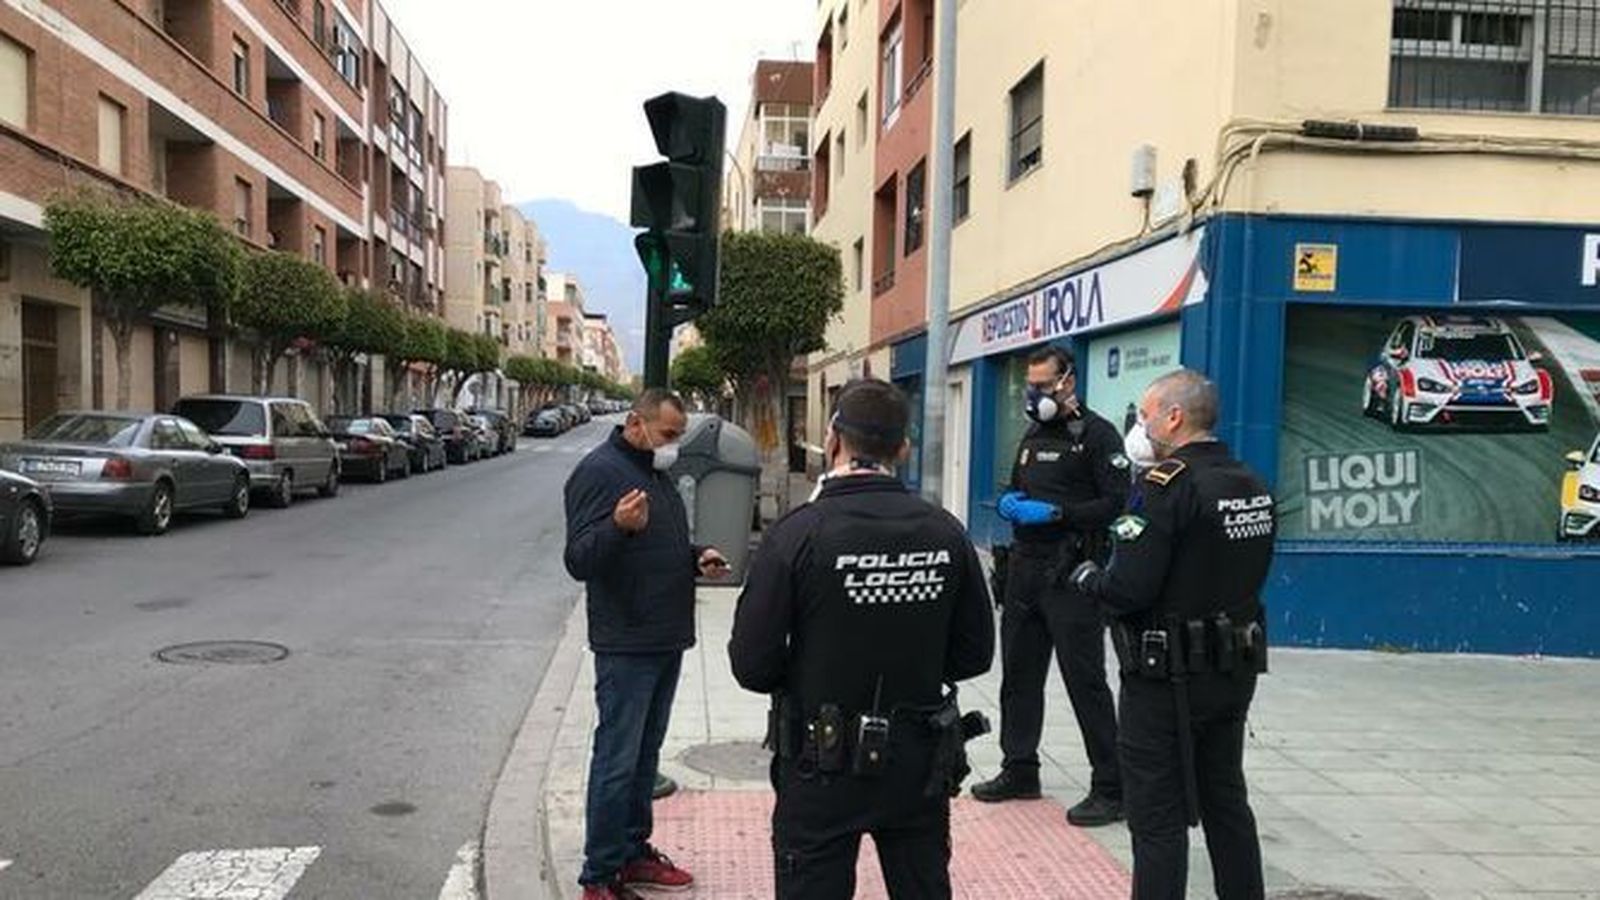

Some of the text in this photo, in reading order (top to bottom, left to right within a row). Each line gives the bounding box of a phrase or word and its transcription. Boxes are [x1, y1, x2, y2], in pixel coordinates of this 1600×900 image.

[982, 272, 1104, 342] REPUESTOS LIROLA
[1308, 452, 1416, 491] LIQUI
[1224, 510, 1272, 526] LOCAL
[1310, 490, 1420, 530] MOLY
[836, 550, 951, 569] POLICIA
[845, 569, 944, 587] LOCAL
